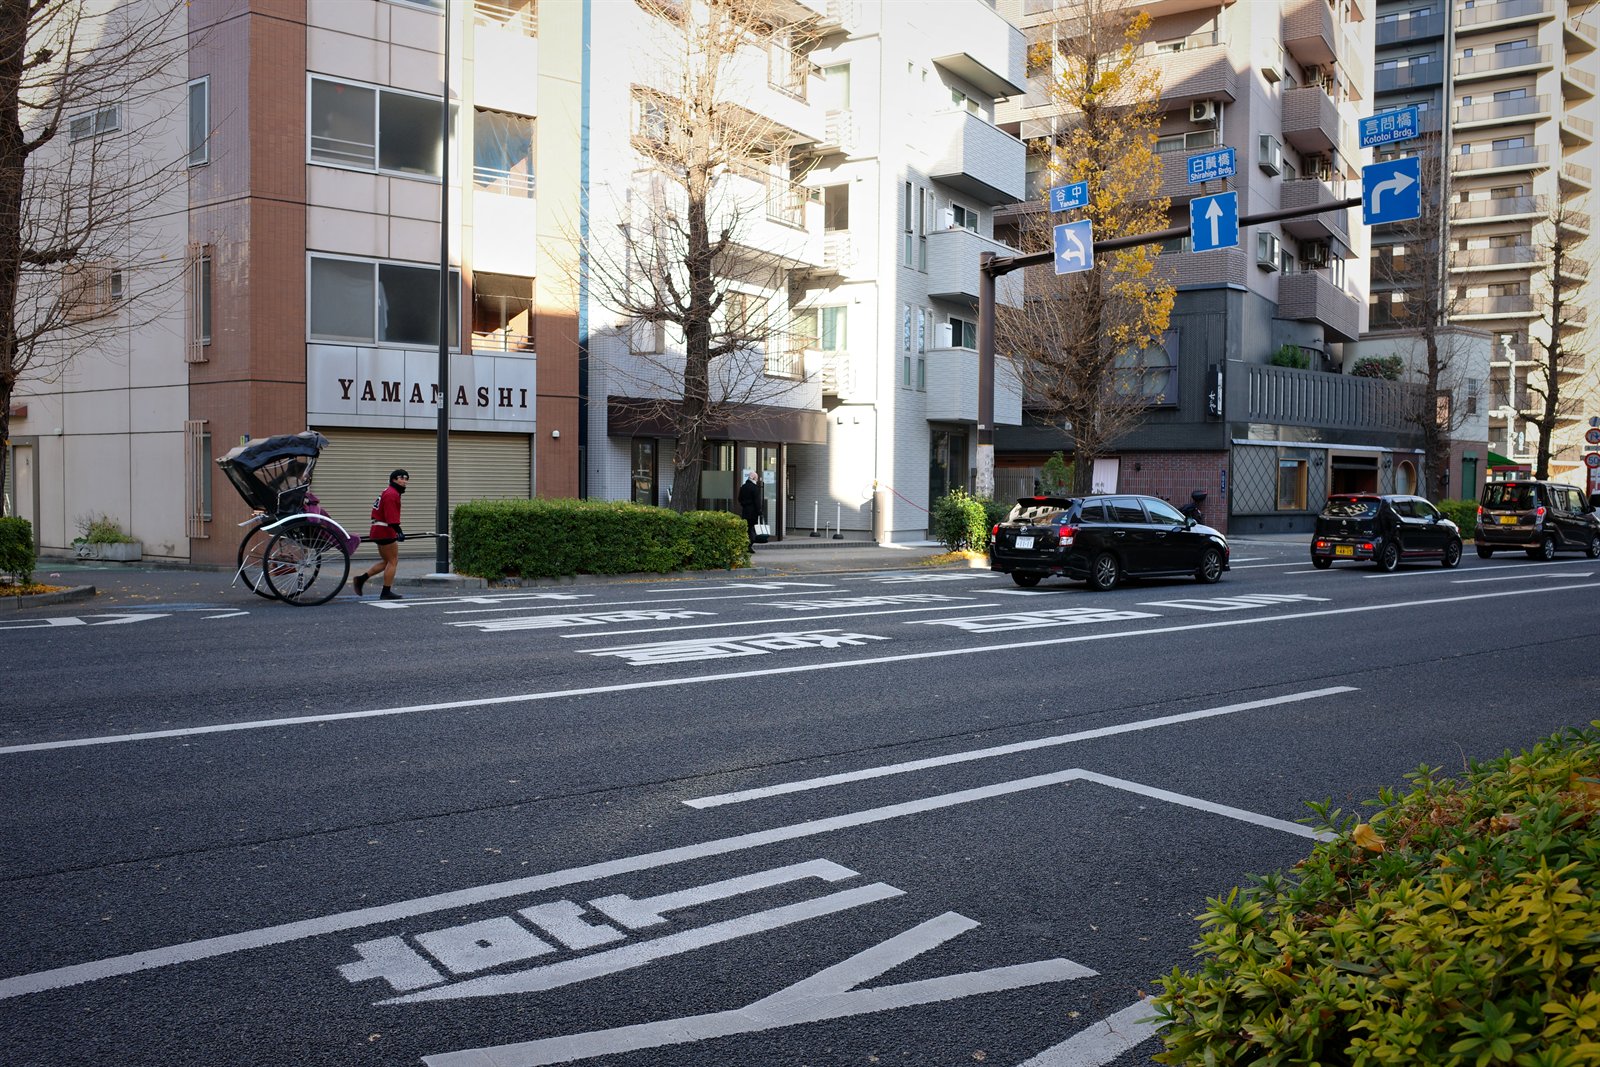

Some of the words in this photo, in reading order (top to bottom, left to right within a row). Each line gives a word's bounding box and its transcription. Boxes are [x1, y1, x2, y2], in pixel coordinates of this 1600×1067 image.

[1365, 112, 1411, 135] 言問橋
[1363, 131, 1392, 145] Kototoi
[1394, 128, 1413, 139] Brdg.
[1193, 154, 1230, 173] 白鬚橋
[1190, 169, 1217, 181] Shirahige
[1218, 165, 1233, 177] Brdg.
[1055, 185, 1082, 202] 谷中
[1059, 198, 1079, 209] Yanaka
[1588, 456, 1599, 465] 50
